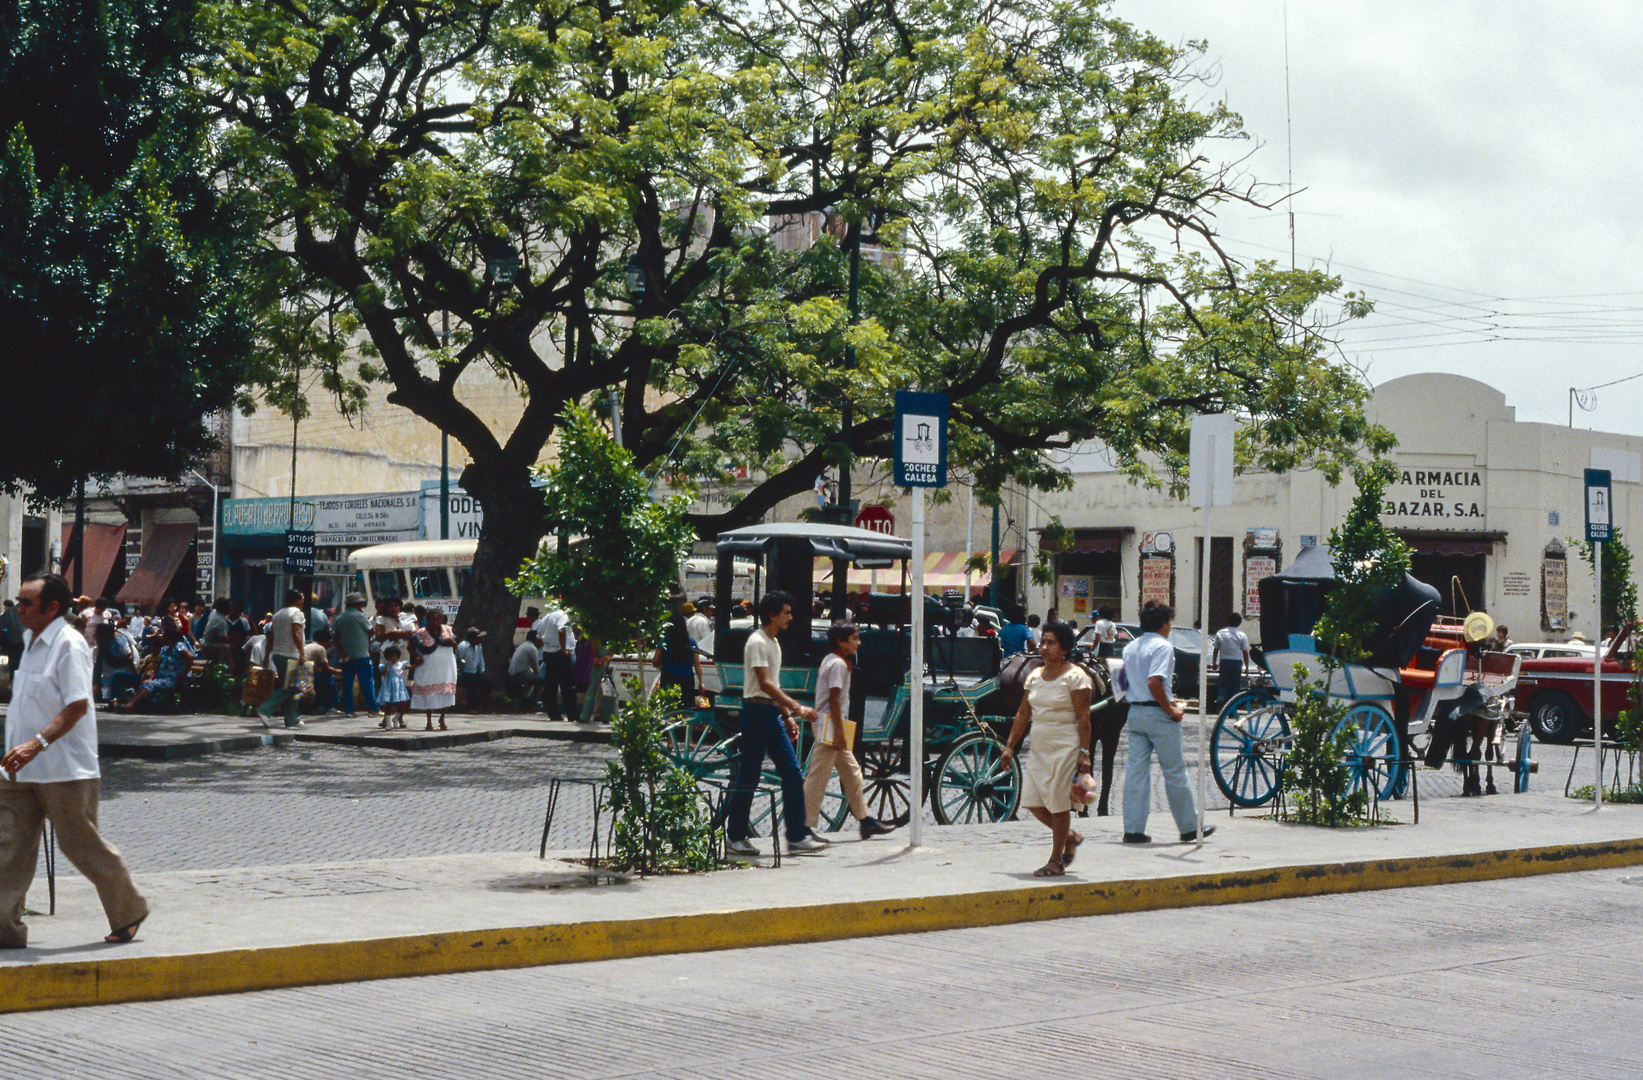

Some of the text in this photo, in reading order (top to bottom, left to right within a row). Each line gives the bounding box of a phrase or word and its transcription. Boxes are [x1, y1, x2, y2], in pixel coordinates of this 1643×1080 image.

[904, 463, 937, 473] COCHES
[904, 473, 937, 482] CALESA
[1391, 470, 1481, 486] ARMACIA
[1420, 489, 1445, 498] DEL
[1454, 502, 1485, 517] S.A.
[223, 504, 233, 526] EL
[859, 519, 892, 535] ALTO
[288, 545, 313, 555] TAXIS
[197, 556, 212, 565] SUPER
